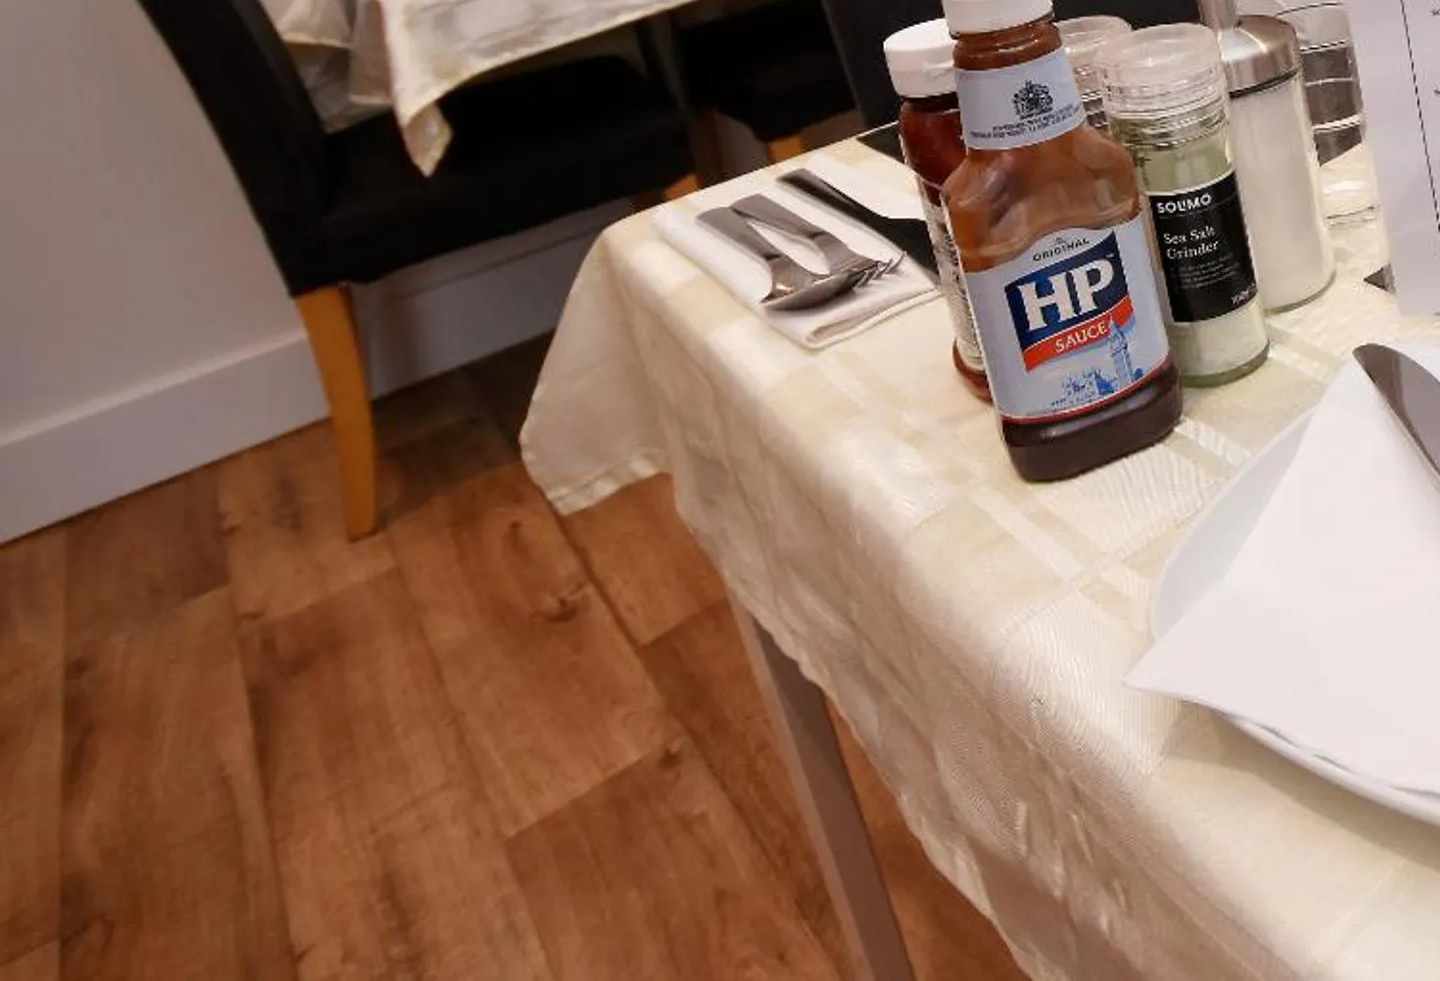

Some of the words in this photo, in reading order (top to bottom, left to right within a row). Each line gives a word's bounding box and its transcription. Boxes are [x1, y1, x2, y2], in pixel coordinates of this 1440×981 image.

[1156, 192, 1213, 214] SOLIMO
[1163, 232, 1188, 245] Sea
[1190, 224, 1217, 241] Salt
[1032, 237, 1091, 262] ORIGINAL
[1165, 239, 1220, 260] Grinder
[1017, 258, 1115, 331] HP
[1053, 320, 1109, 354] SAUCE
